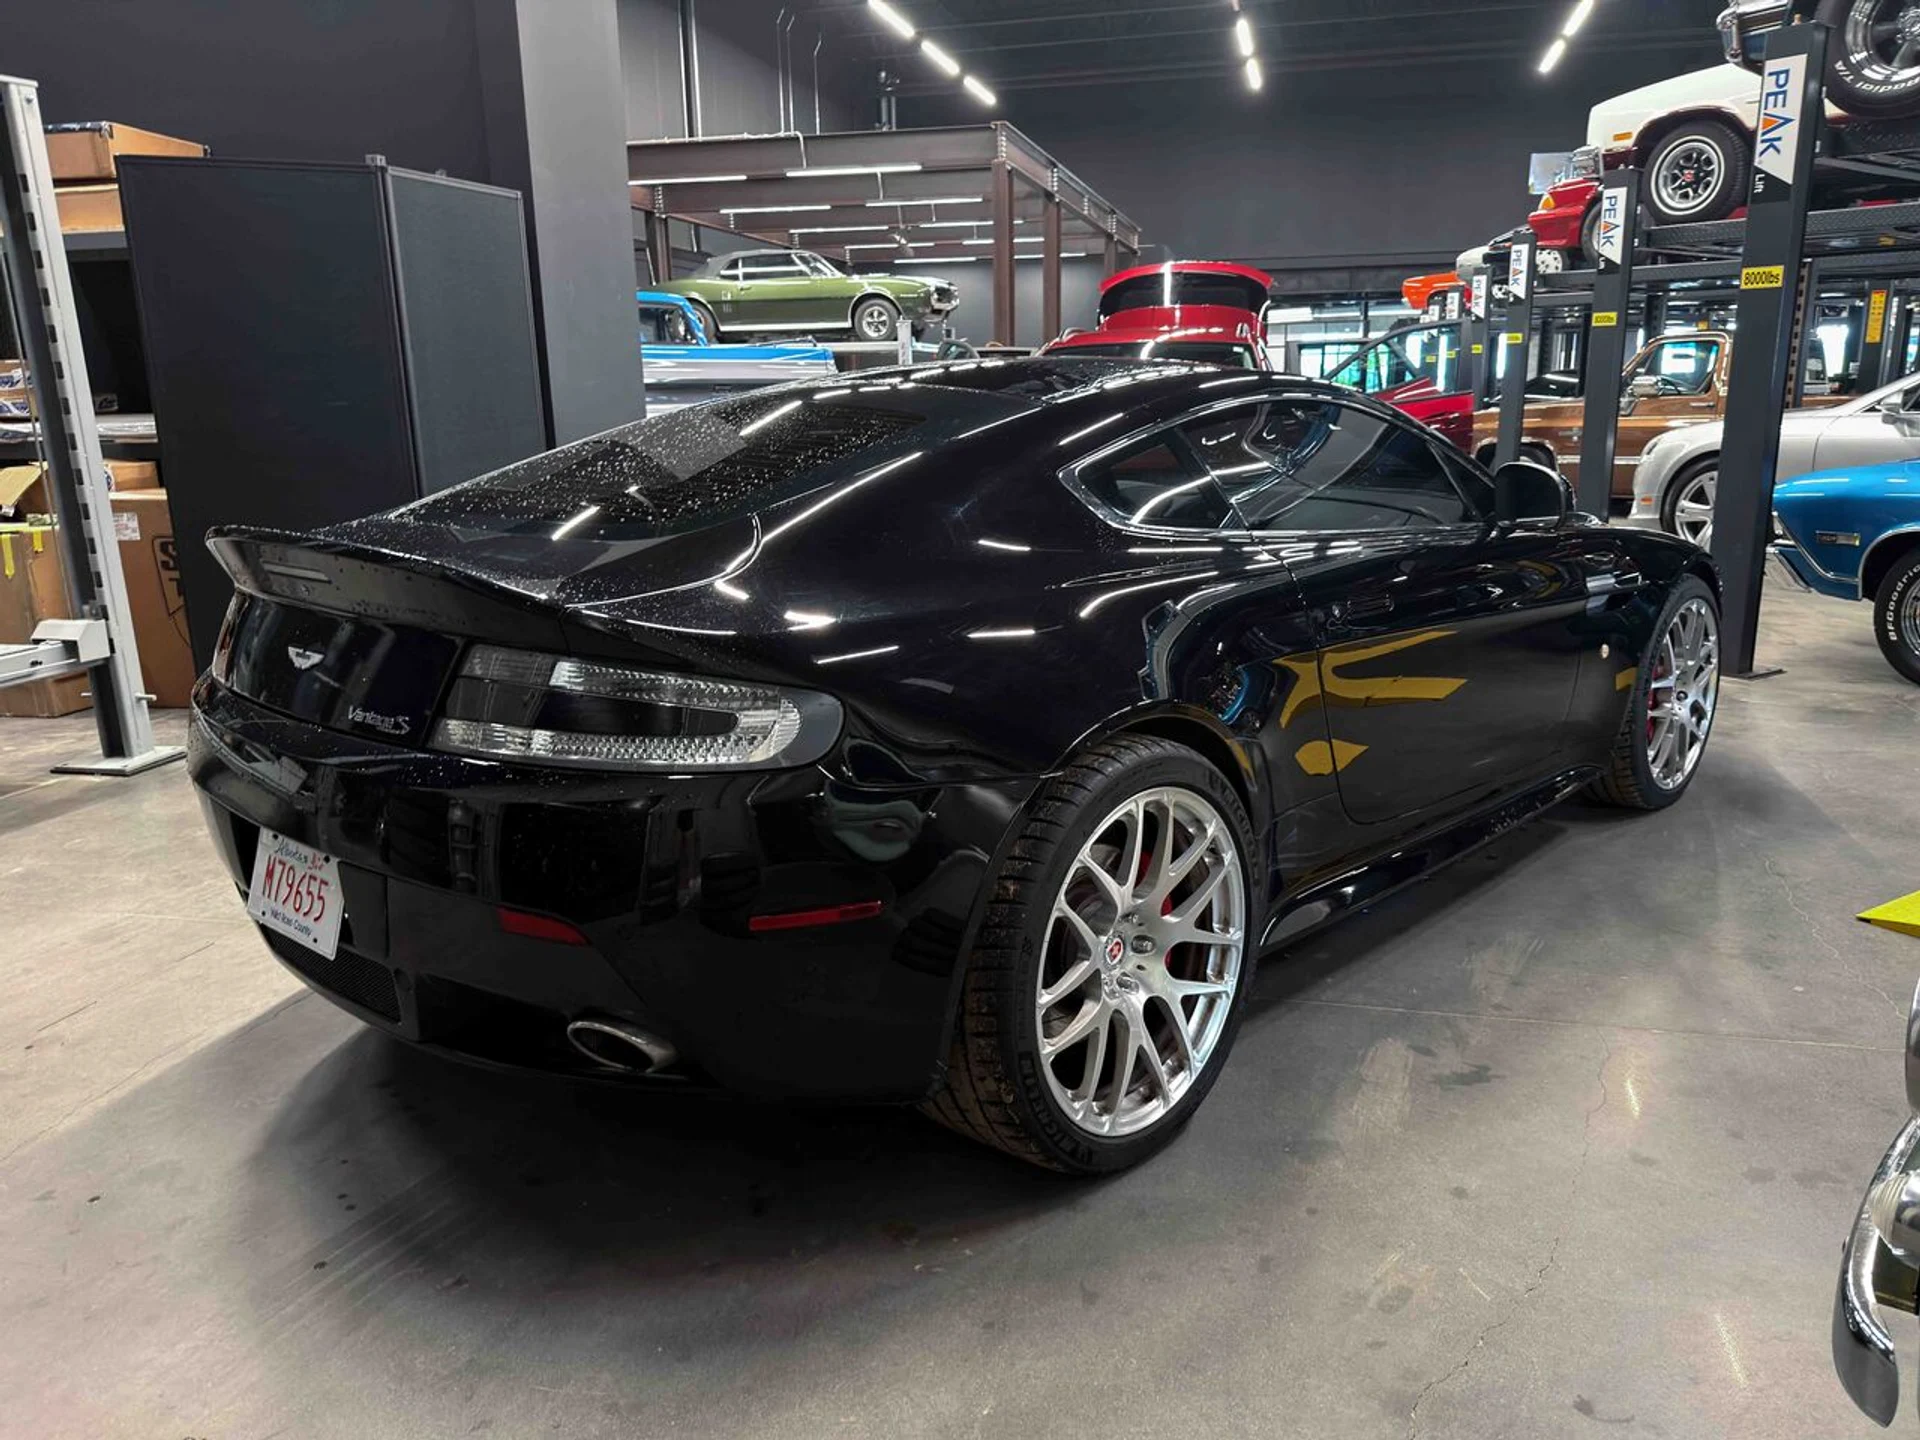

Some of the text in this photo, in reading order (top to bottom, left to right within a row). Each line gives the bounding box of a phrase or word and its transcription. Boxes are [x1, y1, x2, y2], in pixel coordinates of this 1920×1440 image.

[1759, 68, 1796, 157] PEAK
[1754, 173, 1765, 194] Lift
[1600, 195, 1621, 248] PEAK
[1511, 249, 1525, 286] PEAK
[1743, 271, 1780, 286] 8000lbs
